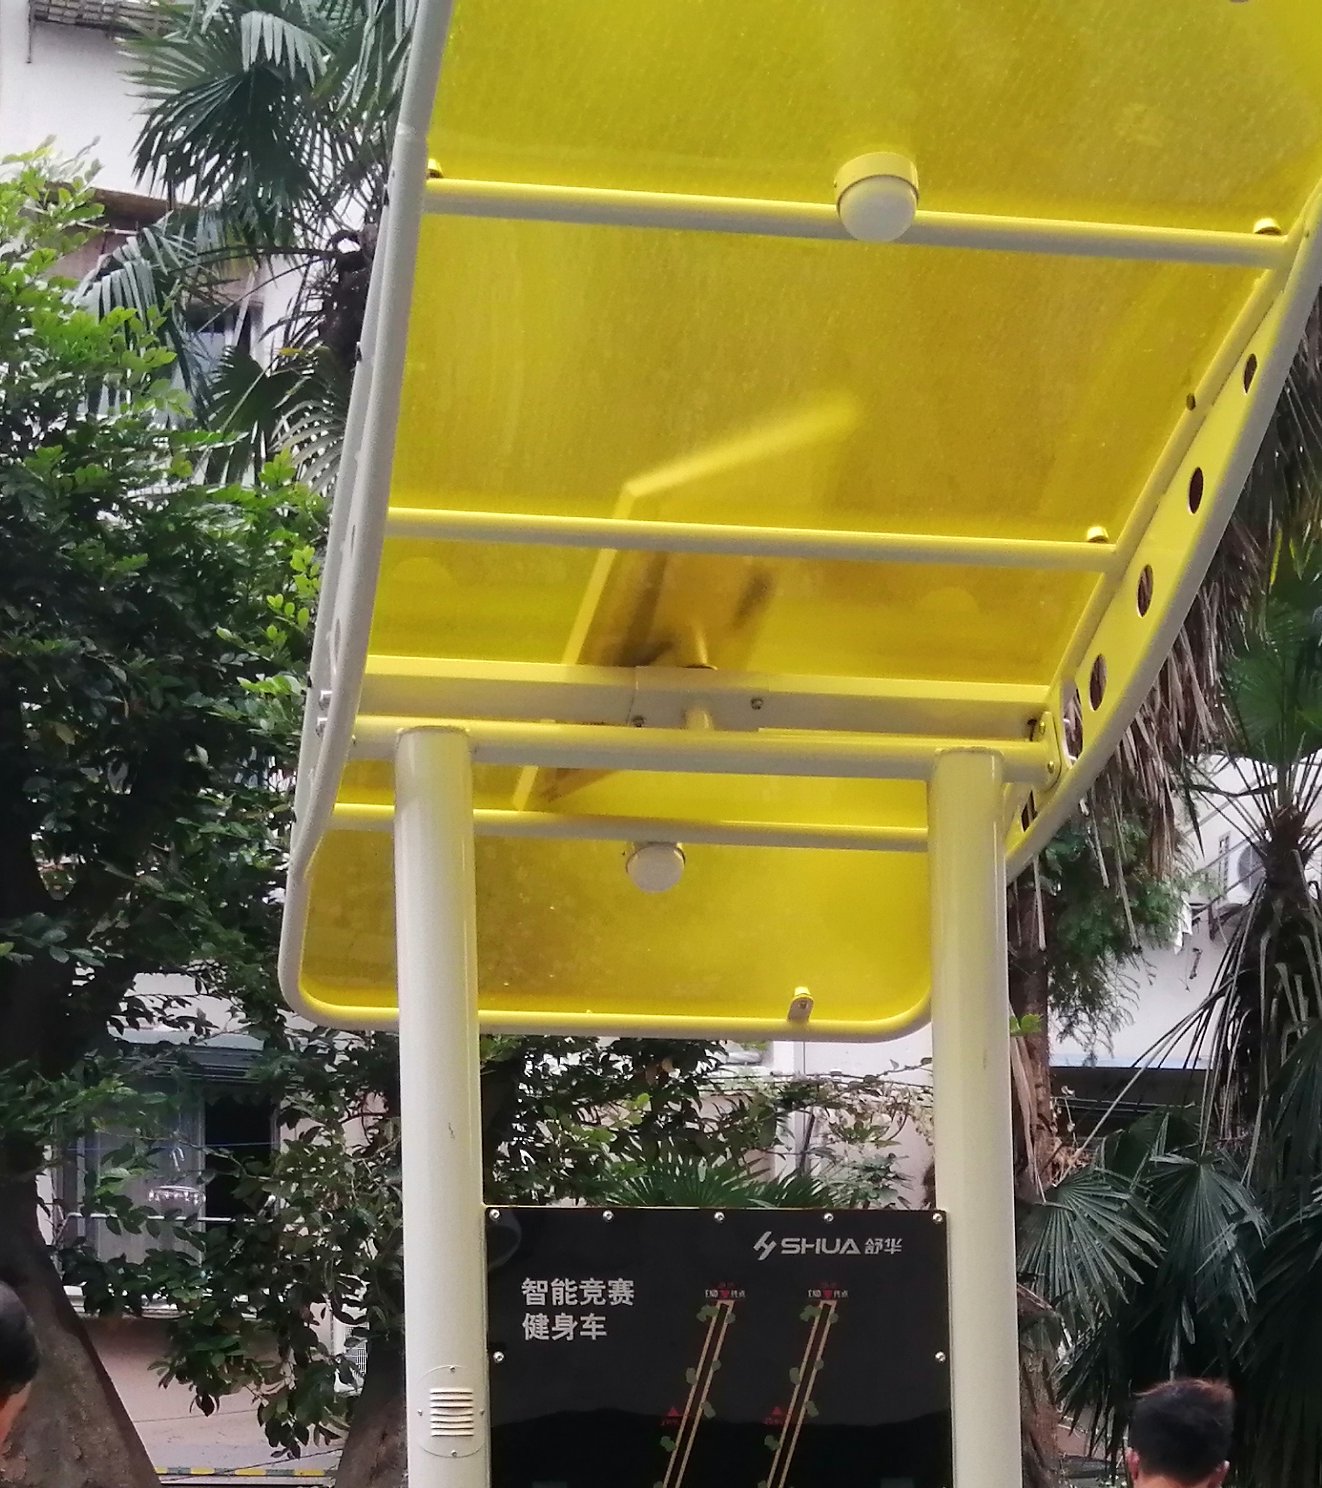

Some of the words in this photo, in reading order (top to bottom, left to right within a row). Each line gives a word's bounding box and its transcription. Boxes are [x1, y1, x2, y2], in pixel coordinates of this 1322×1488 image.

[781, 1238, 861, 1255] SHUA
[865, 1238, 903, 1255] 舒华
[521, 1277, 635, 1306] 智能竞赛
[522, 1312, 607, 1341] 健身车
